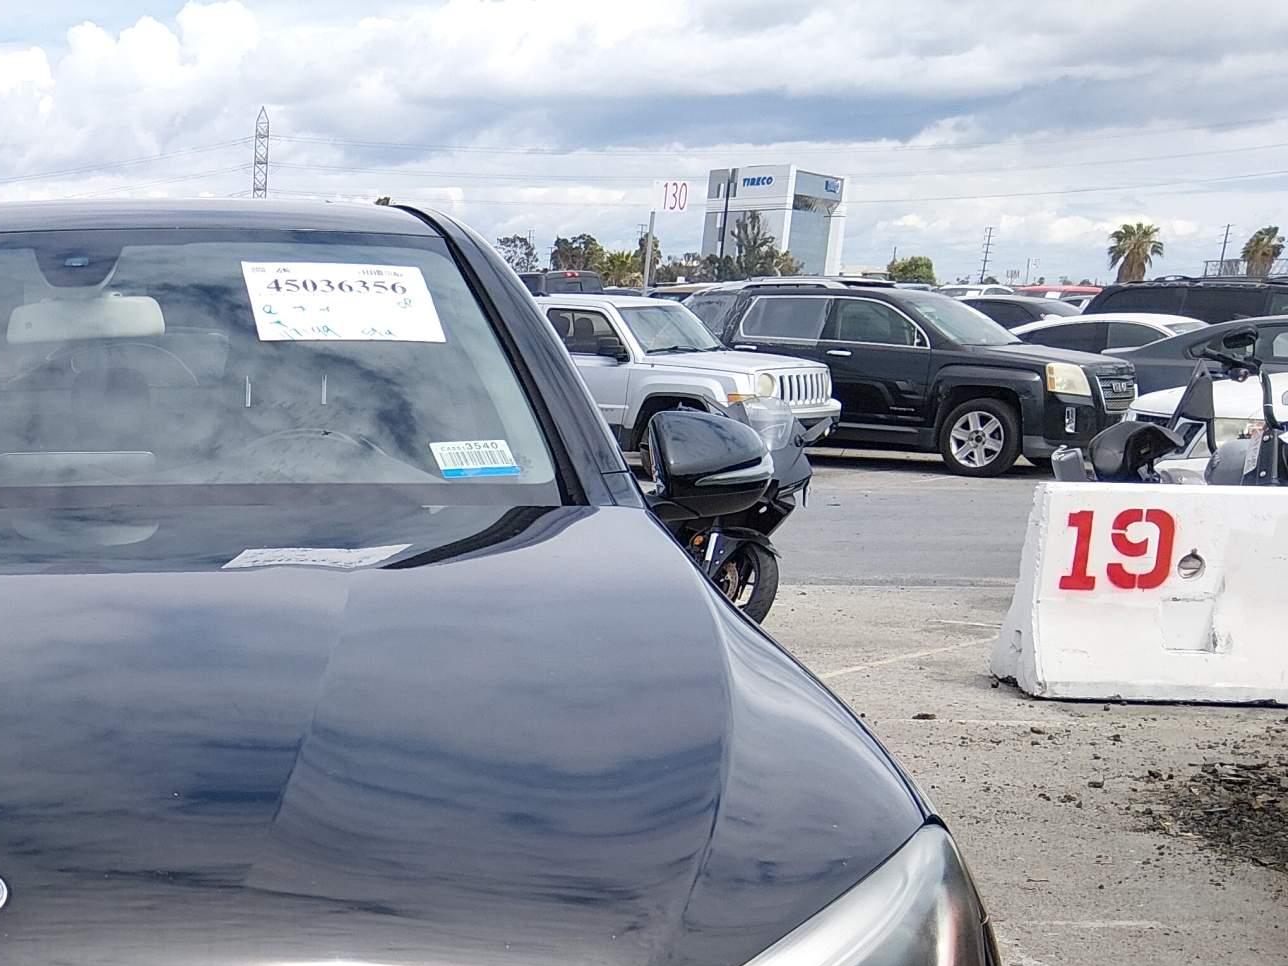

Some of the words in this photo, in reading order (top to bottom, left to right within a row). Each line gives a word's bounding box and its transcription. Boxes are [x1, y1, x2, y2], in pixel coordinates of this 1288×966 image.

[742, 176, 773, 188] TIRECO
[663, 182, 688, 210] 130
[266, 278, 407, 295] 45036356
[465, 441, 498, 450] 3540
[1059, 509, 1175, 590] 19
